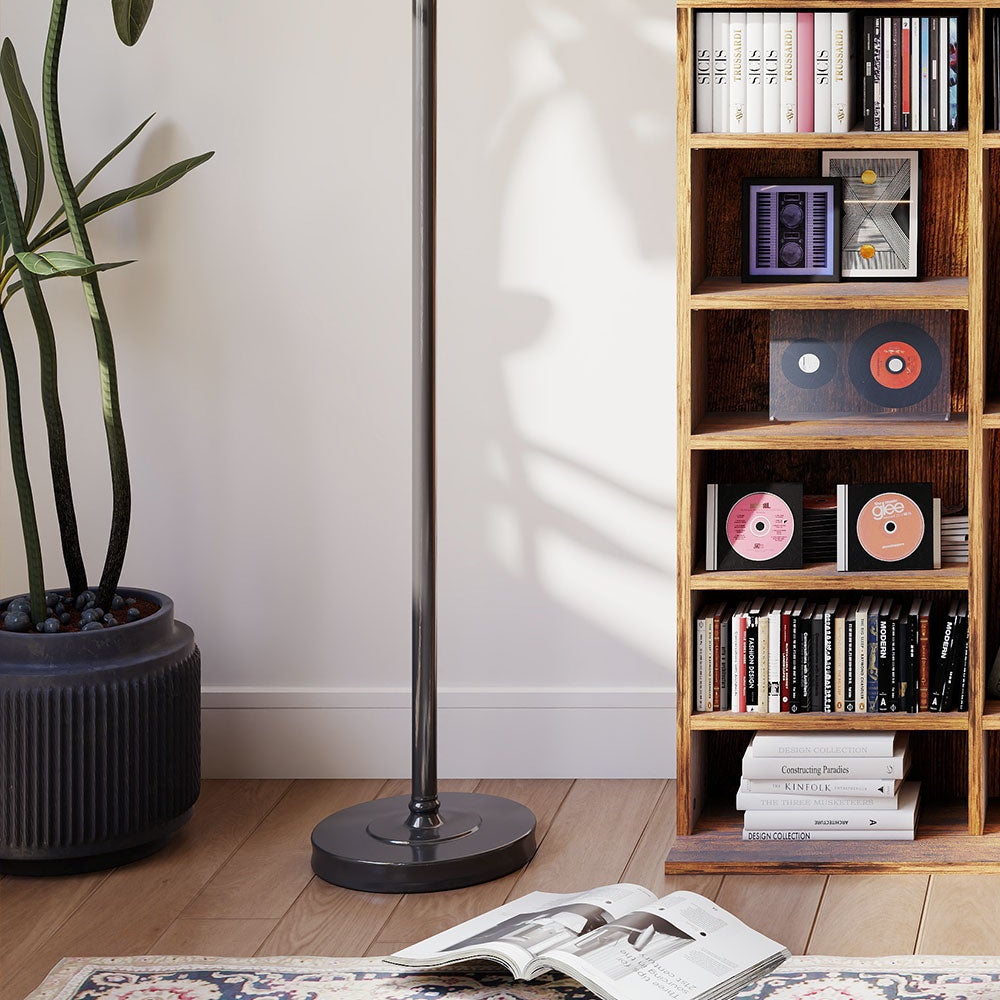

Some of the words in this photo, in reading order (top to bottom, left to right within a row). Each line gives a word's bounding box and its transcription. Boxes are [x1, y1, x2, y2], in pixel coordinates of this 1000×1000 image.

[697, 49, 710, 85] SICIS
[714, 49, 727, 85] SICIS
[733, 29, 742, 82] TRUSSARDI
[748, 49, 761, 85] SICIS
[765, 49, 778, 85] SICIS
[784, 29, 793, 82] TRUSSARDI
[816, 49, 829, 85] SICIS
[835, 29, 844, 82] TRUSSARDI
[872, 502, 905, 521] glee
[941, 621, 953, 659] MODERN
[781, 765, 821, 776] Constructing
[823, 765, 849, 774] Paradies
[785, 782, 832, 792] KINFOLK
[748, 832, 772, 840] DESIGN
[773, 832, 811, 840] COLLECTION
